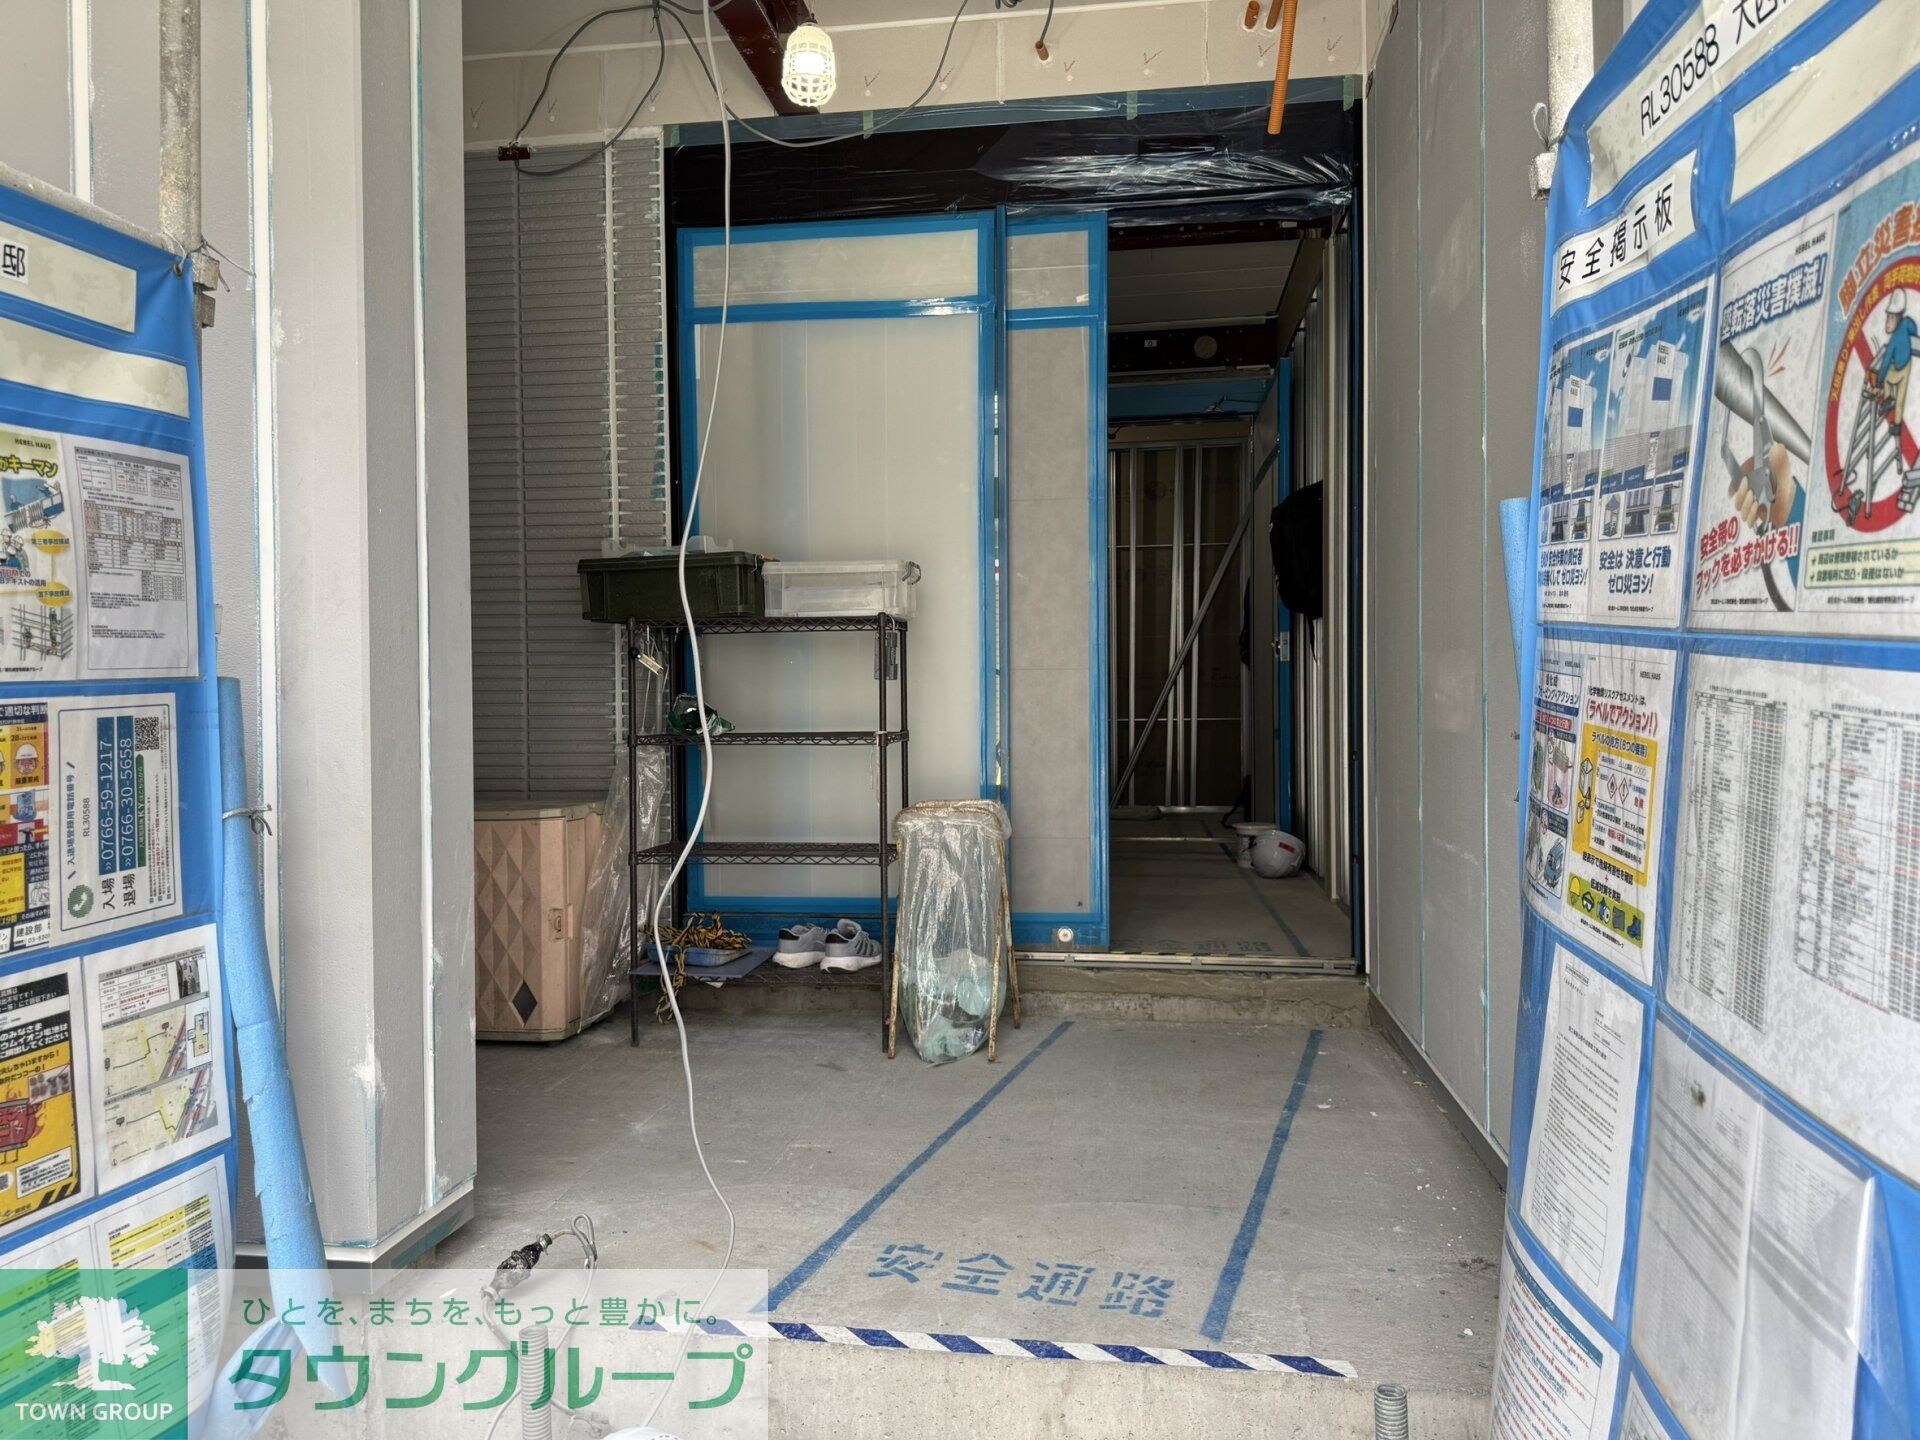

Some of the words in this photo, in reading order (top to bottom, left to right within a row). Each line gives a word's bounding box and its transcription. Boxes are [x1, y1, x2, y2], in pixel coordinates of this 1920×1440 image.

[1640, 24, 1720, 136] RL30588
[1558, 183, 1673, 290] 安全掲示板
[2, 244, 26, 278] 邸
[1599, 550, 1624, 570] 安全は
[1626, 545, 1671, 569] 決意と行動
[1700, 516, 1738, 560] 安全帯の
[1608, 574, 1654, 594] ゼロ災ヨシ!
[100, 740, 115, 861] 0766-59-1217
[119, 737, 134, 857] 0766-30-5658
[102, 877, 116, 910] 入場
[123, 873, 137, 907] 退場
[867, 1243, 1179, 1319] 安全通路
